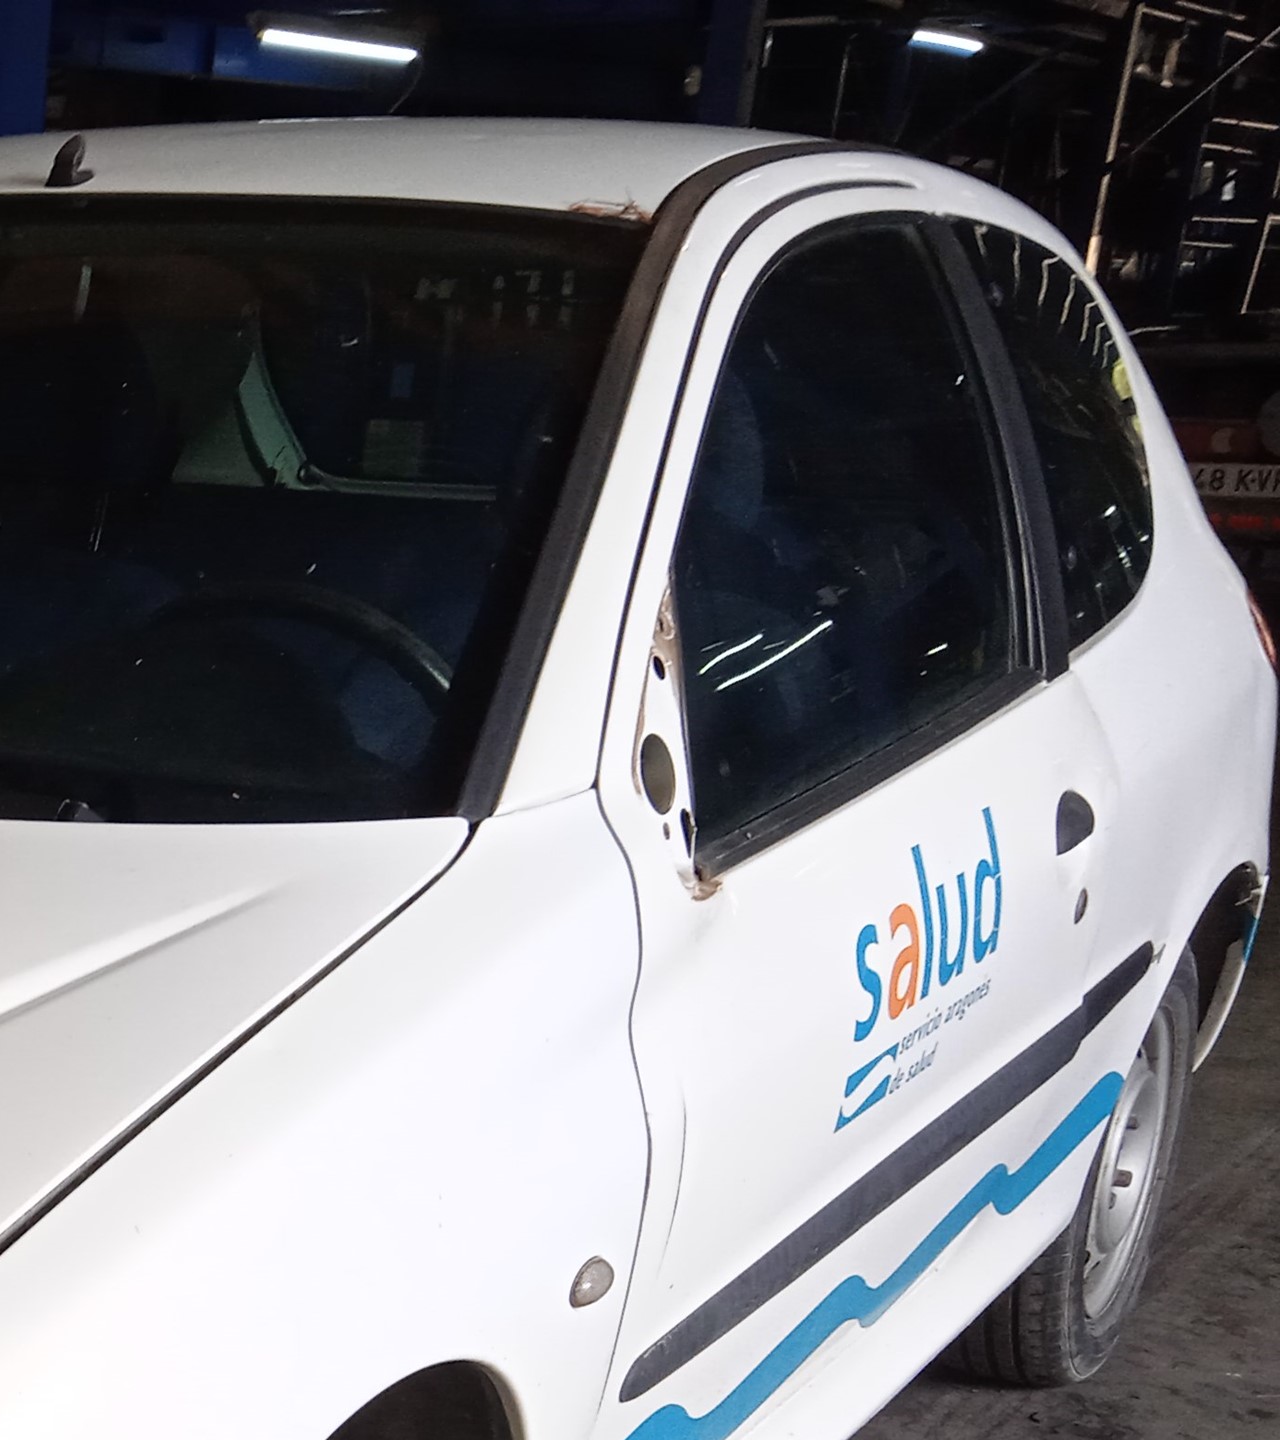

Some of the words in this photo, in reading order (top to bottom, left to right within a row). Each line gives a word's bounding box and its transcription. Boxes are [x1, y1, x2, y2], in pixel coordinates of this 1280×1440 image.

[853, 806, 1002, 1042] salud
[899, 1006, 942, 1055] servicio
[889, 1067, 905, 1094] de
[905, 1041, 939, 1083] salud
